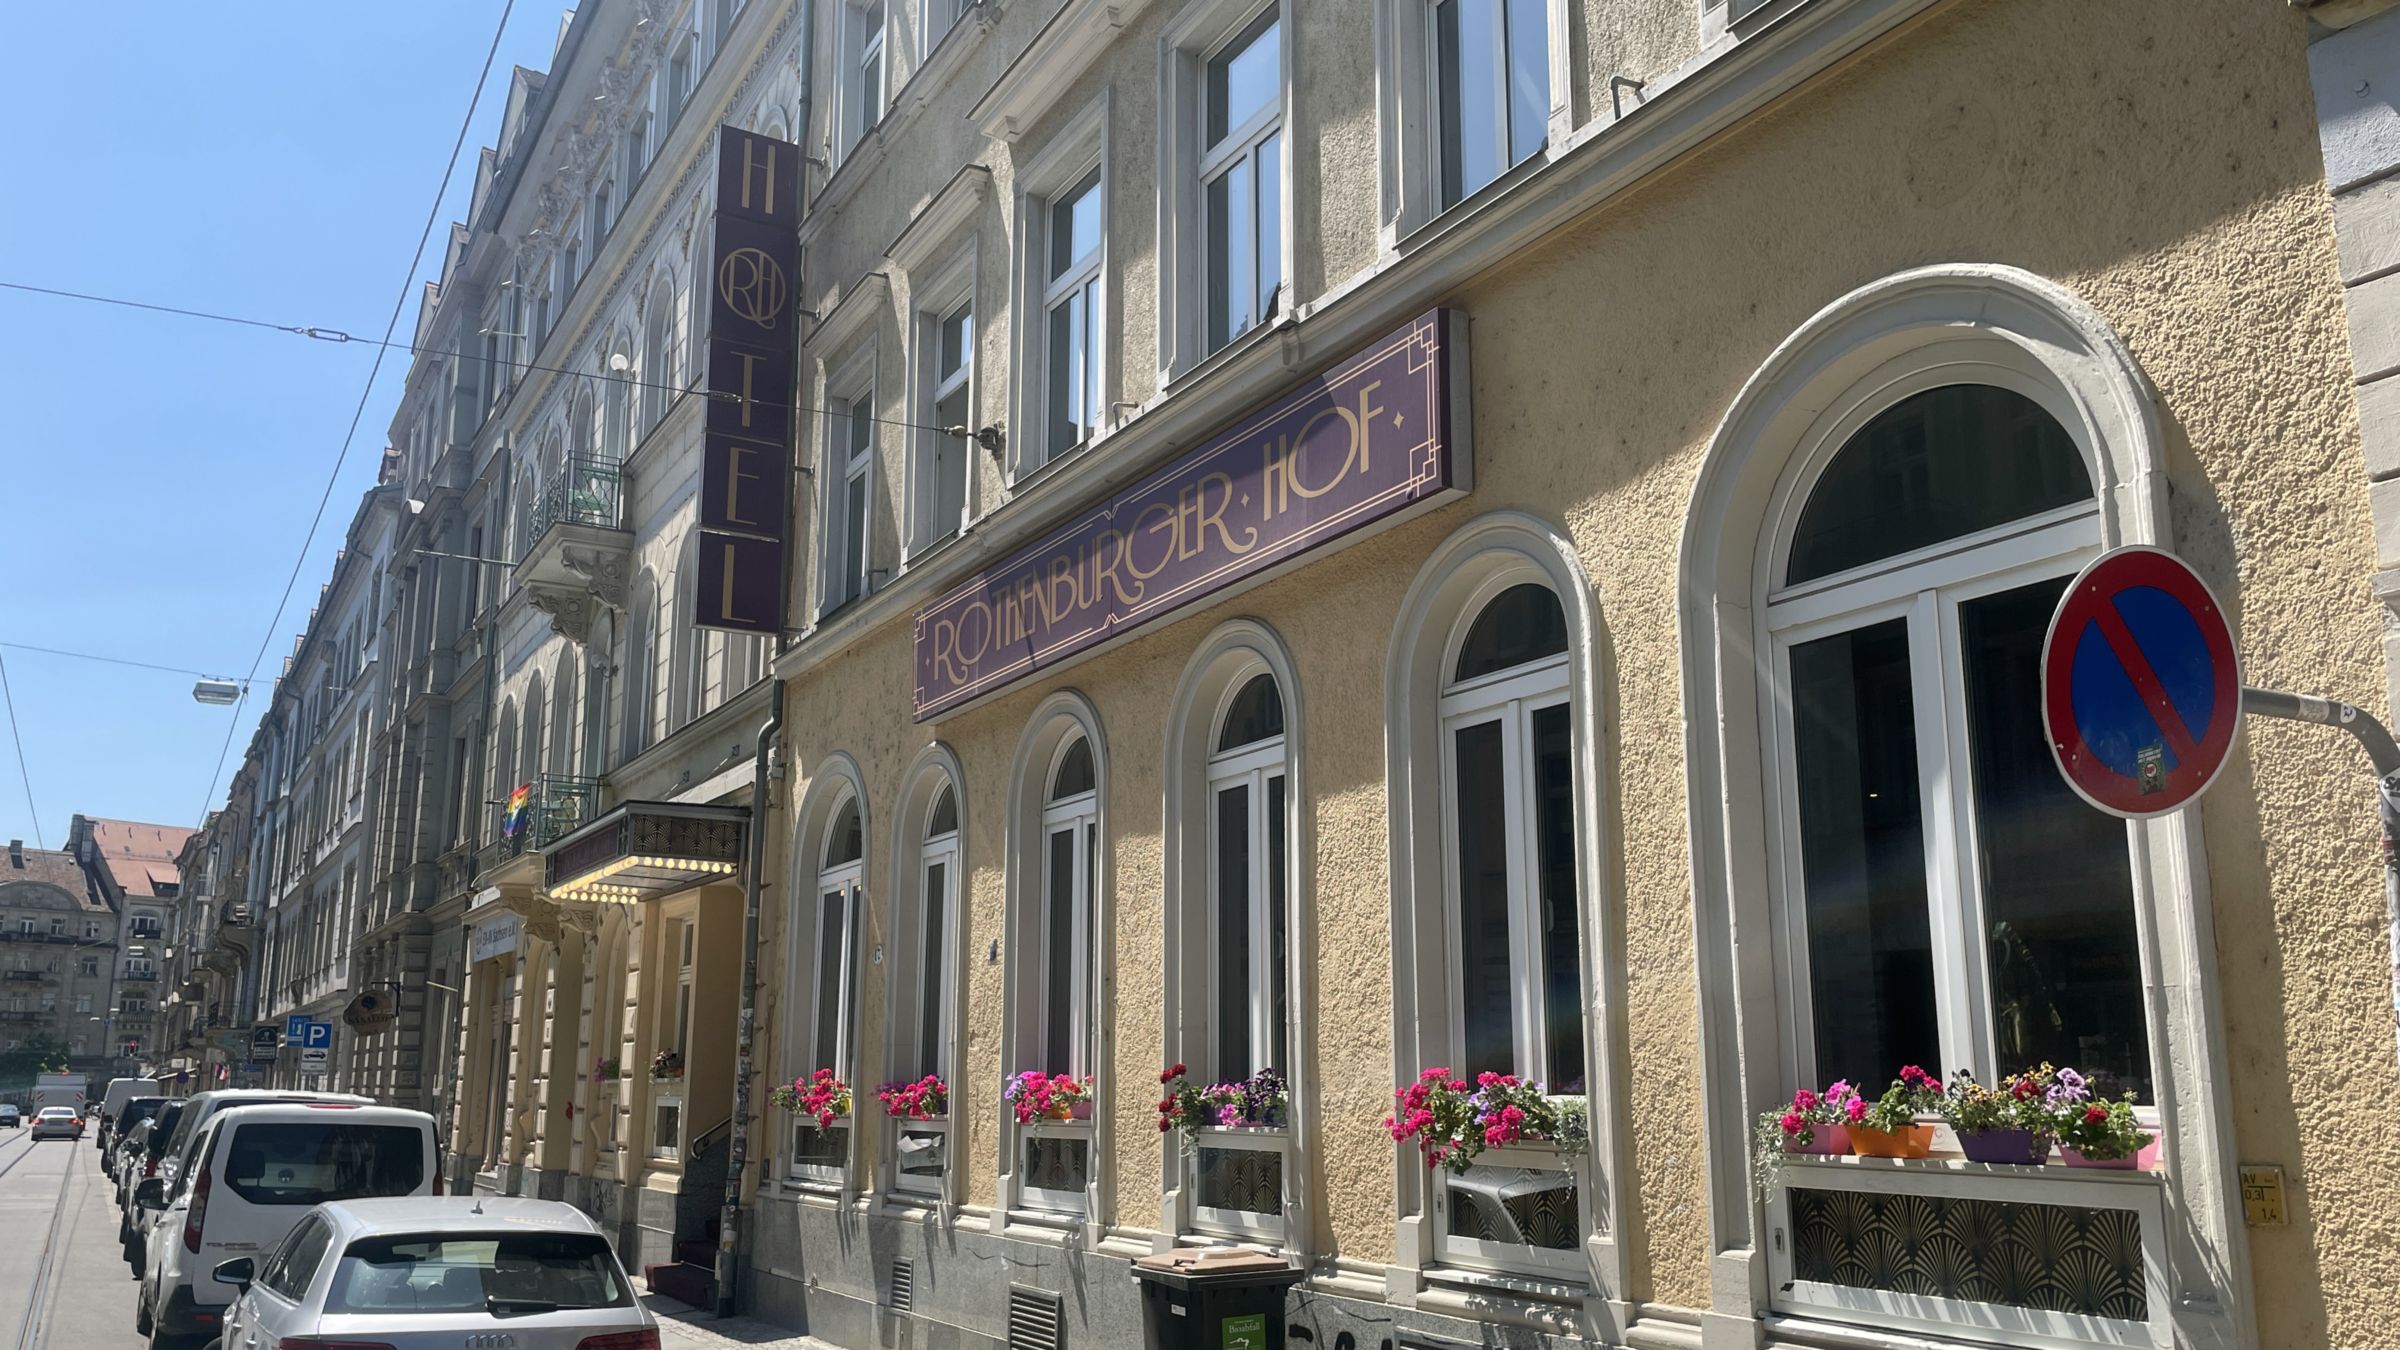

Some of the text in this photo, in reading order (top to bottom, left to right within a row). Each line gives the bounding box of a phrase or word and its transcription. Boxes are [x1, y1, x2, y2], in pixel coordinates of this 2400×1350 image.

[934, 381, 1384, 686] ROTHENBURGER HOF
[308, 1025, 326, 1046] P
